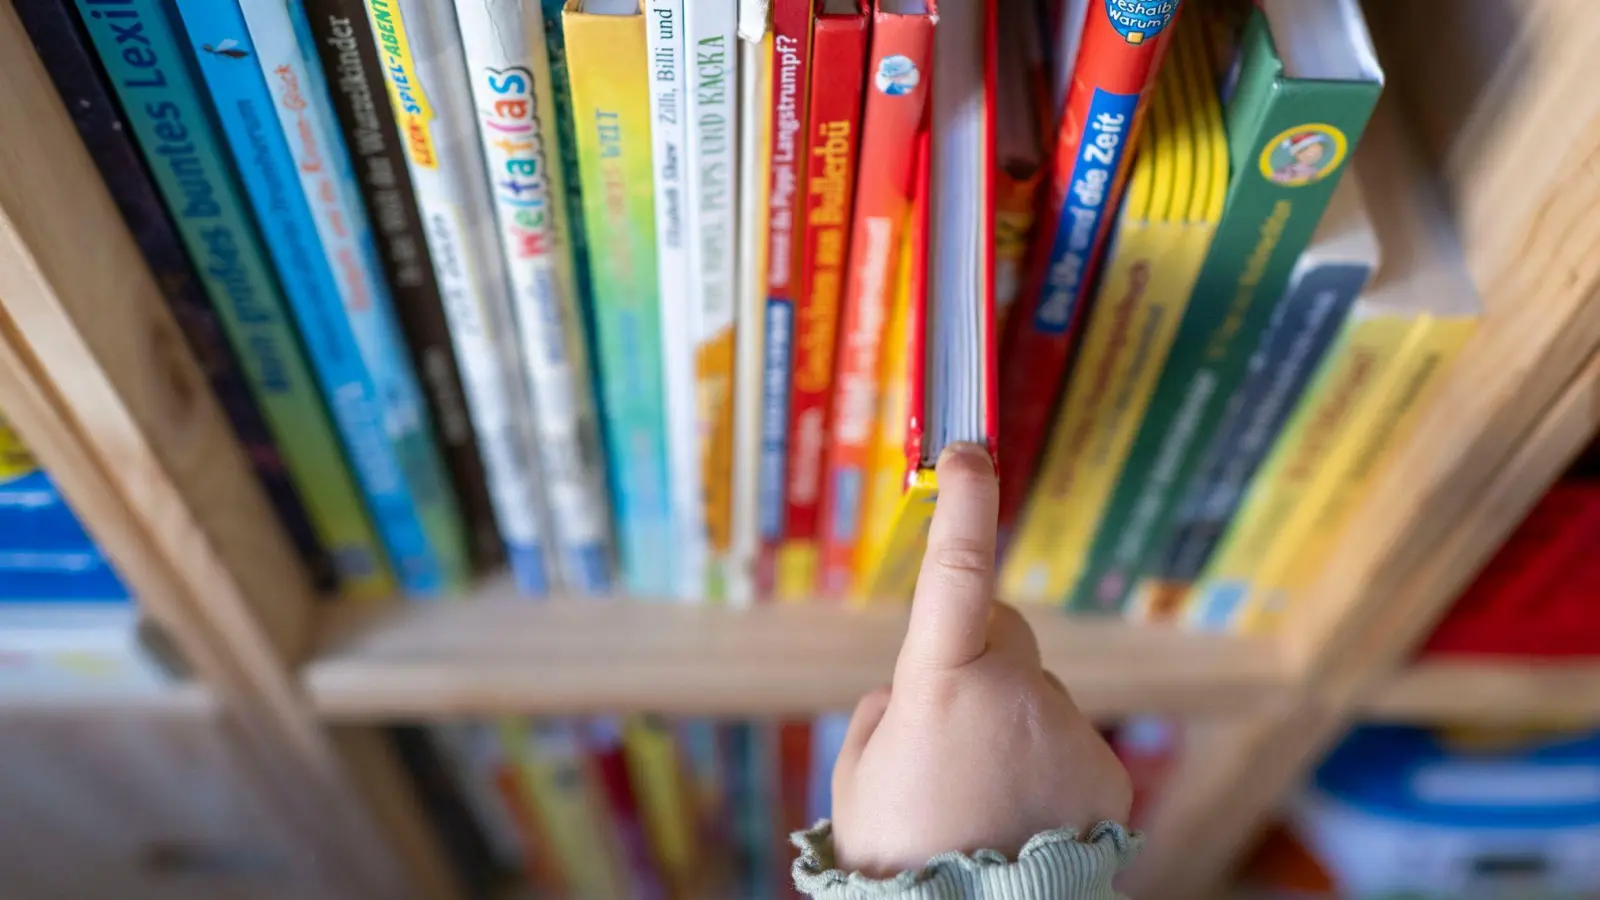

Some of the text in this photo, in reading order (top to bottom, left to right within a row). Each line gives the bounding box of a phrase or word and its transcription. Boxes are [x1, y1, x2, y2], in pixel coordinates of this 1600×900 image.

[653, 8, 674, 40] und
[1109, 5, 1171, 28] Warum?
[84, 0, 168, 88] Lexi
[655, 48, 676, 82] Billi
[696, 34, 726, 106] KACKA
[658, 89, 678, 125] Zilli,
[775, 35, 801, 165] Langstrumpf?
[146, 100, 221, 216] buntes
[1083, 112, 1125, 164] Zeit
[808, 120, 852, 226] Bullerbü
[1074, 168, 1109, 206] die
